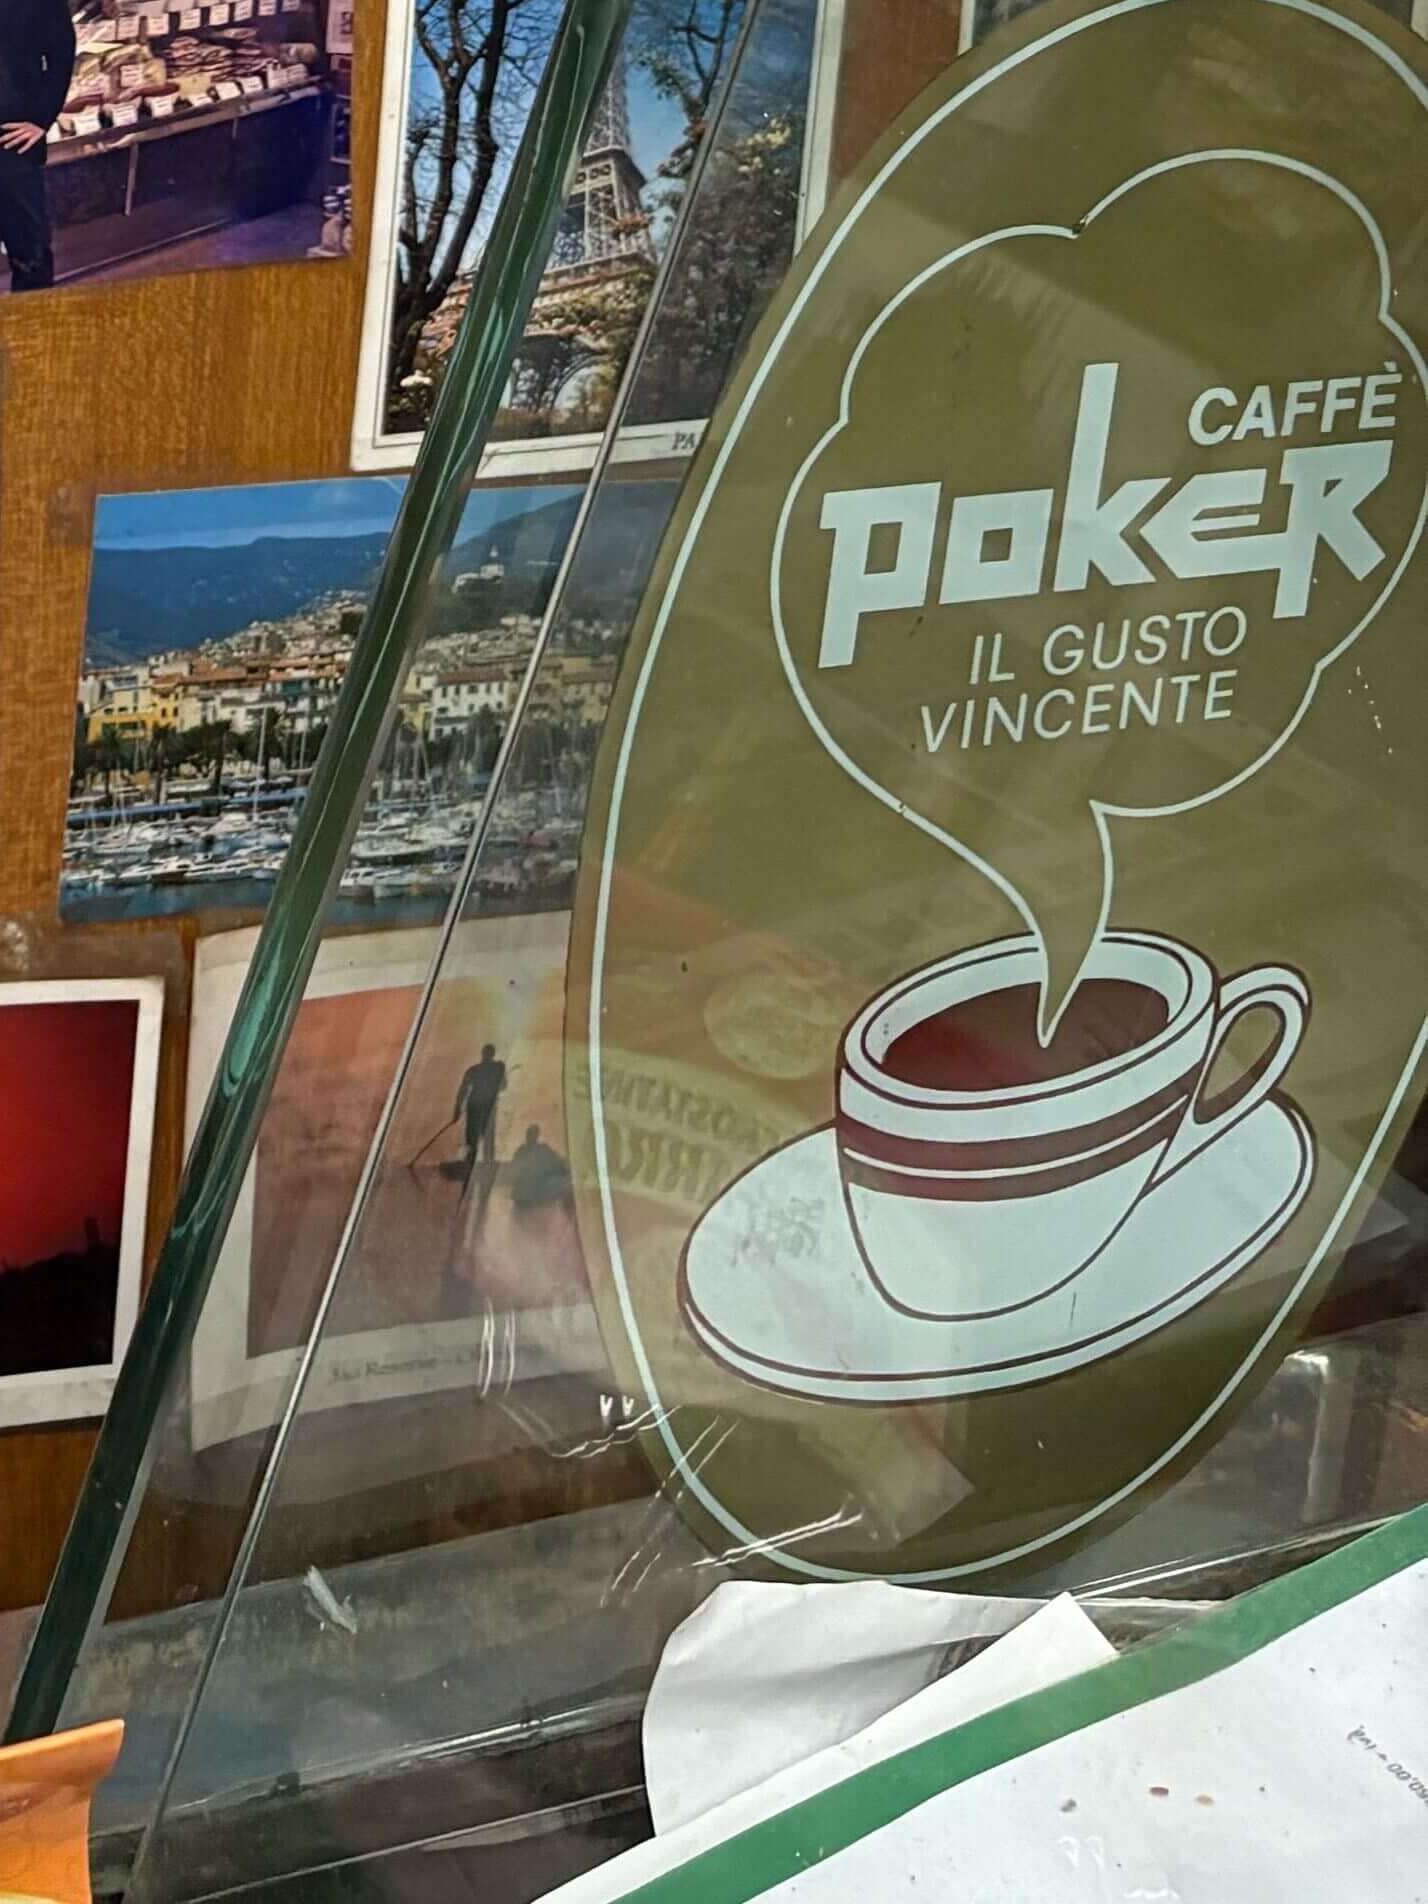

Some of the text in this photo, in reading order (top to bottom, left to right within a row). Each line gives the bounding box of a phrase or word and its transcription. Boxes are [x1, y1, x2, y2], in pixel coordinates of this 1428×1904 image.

[1188, 361, 1403, 445] CAFFÈ
[969, 606, 1247, 682] IL GUSTO
[920, 670, 1238, 754] VINCENTE
